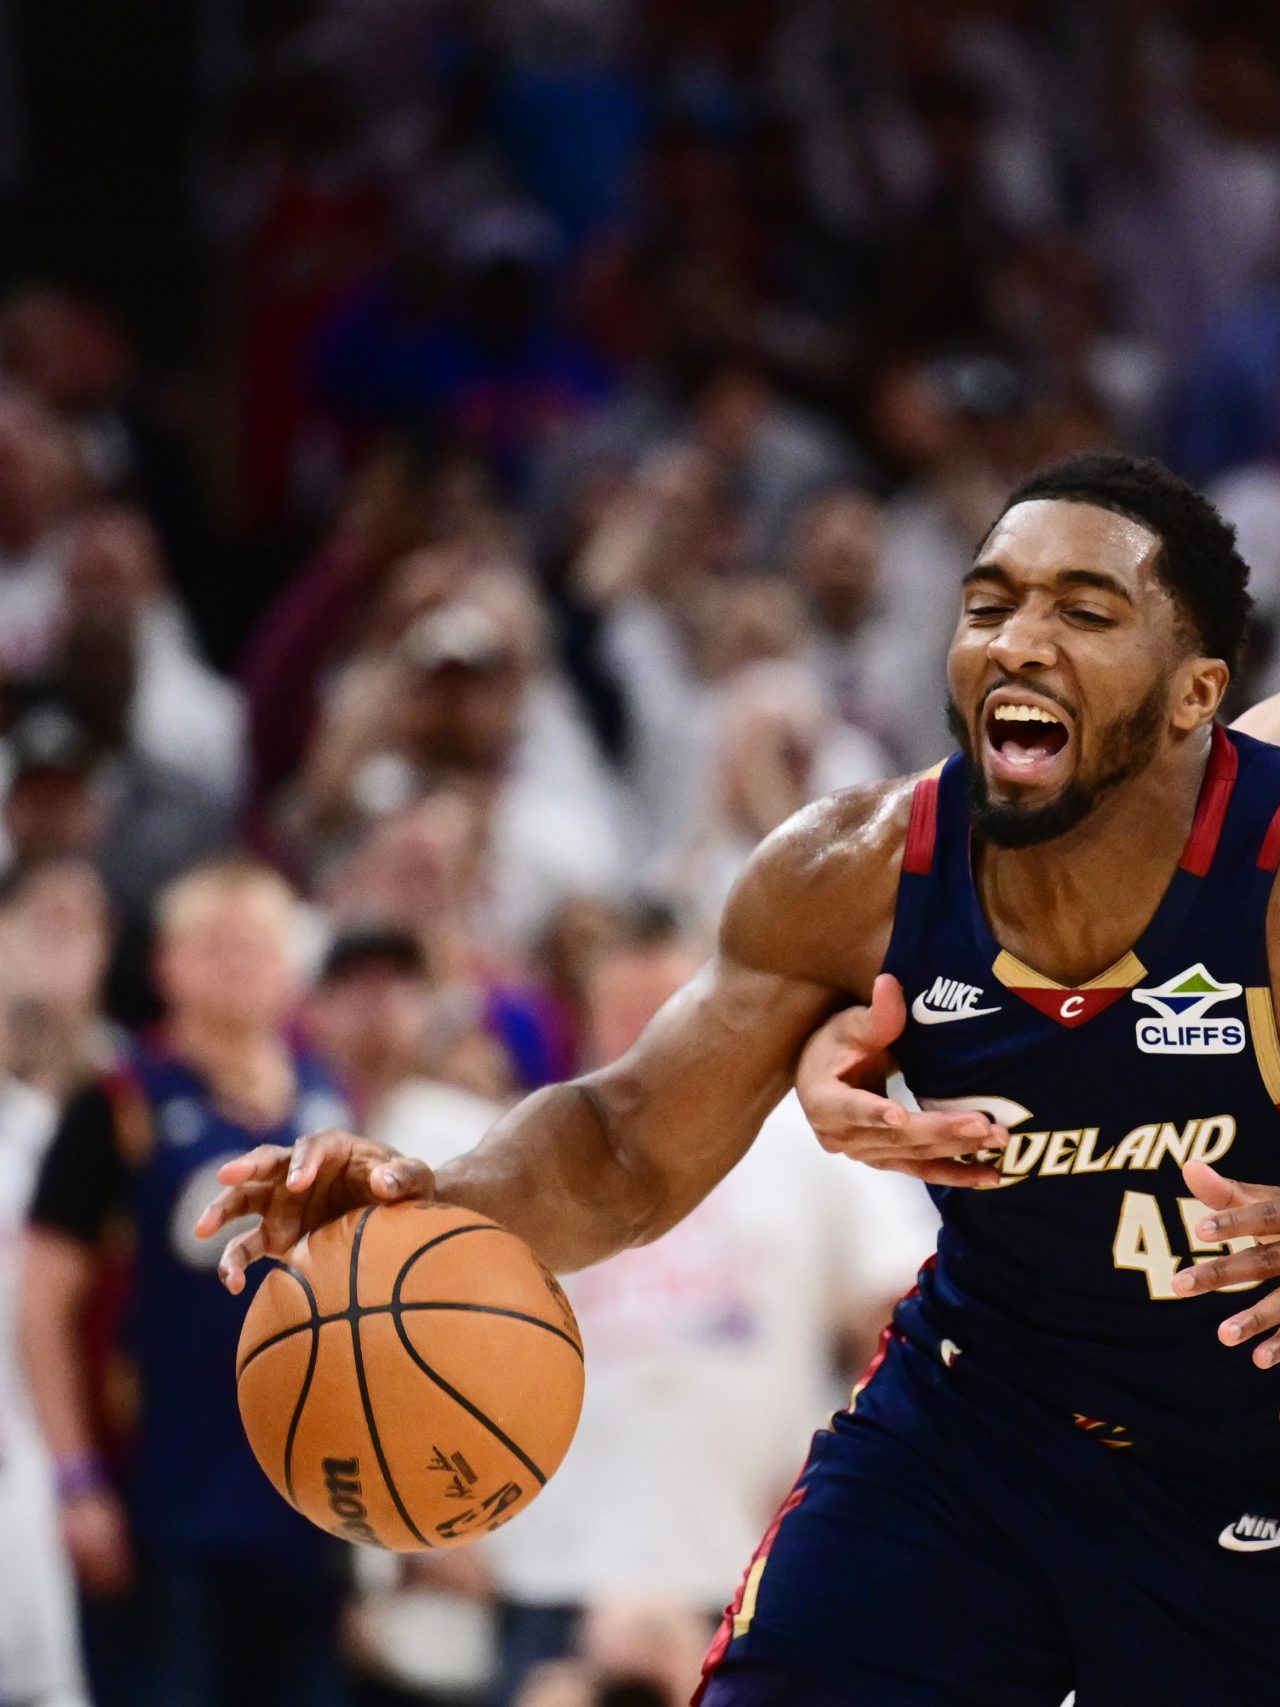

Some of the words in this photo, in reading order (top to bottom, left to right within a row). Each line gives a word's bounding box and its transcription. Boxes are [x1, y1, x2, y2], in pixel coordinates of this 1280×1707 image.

[925, 976, 984, 1012] NIKE
[1060, 996, 1085, 1018] C
[1141, 1025, 1242, 1047] CLIFFS
[918, 1095, 1237, 1190] CVELAND
